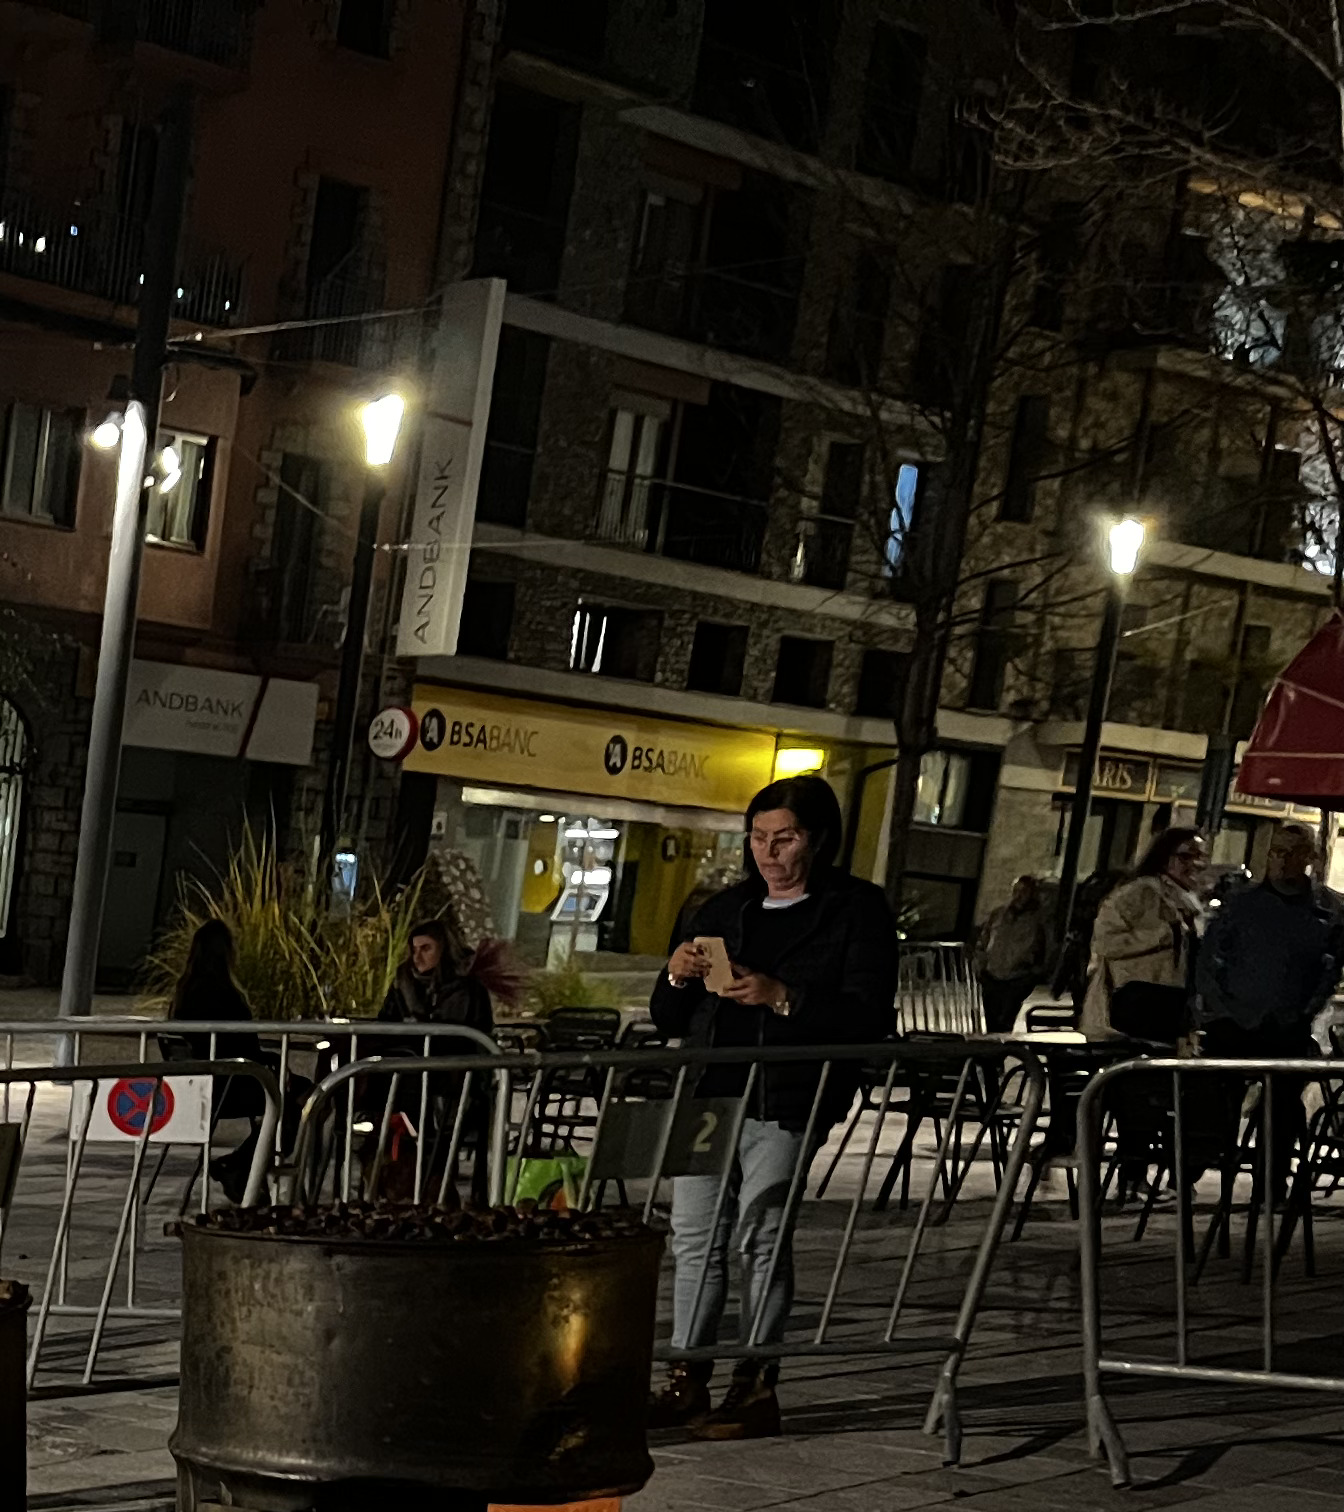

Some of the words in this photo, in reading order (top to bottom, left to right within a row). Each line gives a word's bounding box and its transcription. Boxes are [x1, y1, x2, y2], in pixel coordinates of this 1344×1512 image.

[414, 457, 453, 645] ANDBANK
[135, 689, 243, 718] ANDBANK
[449, 720, 539, 758] BSABANC
[692, 1111, 719, 1153] 2
